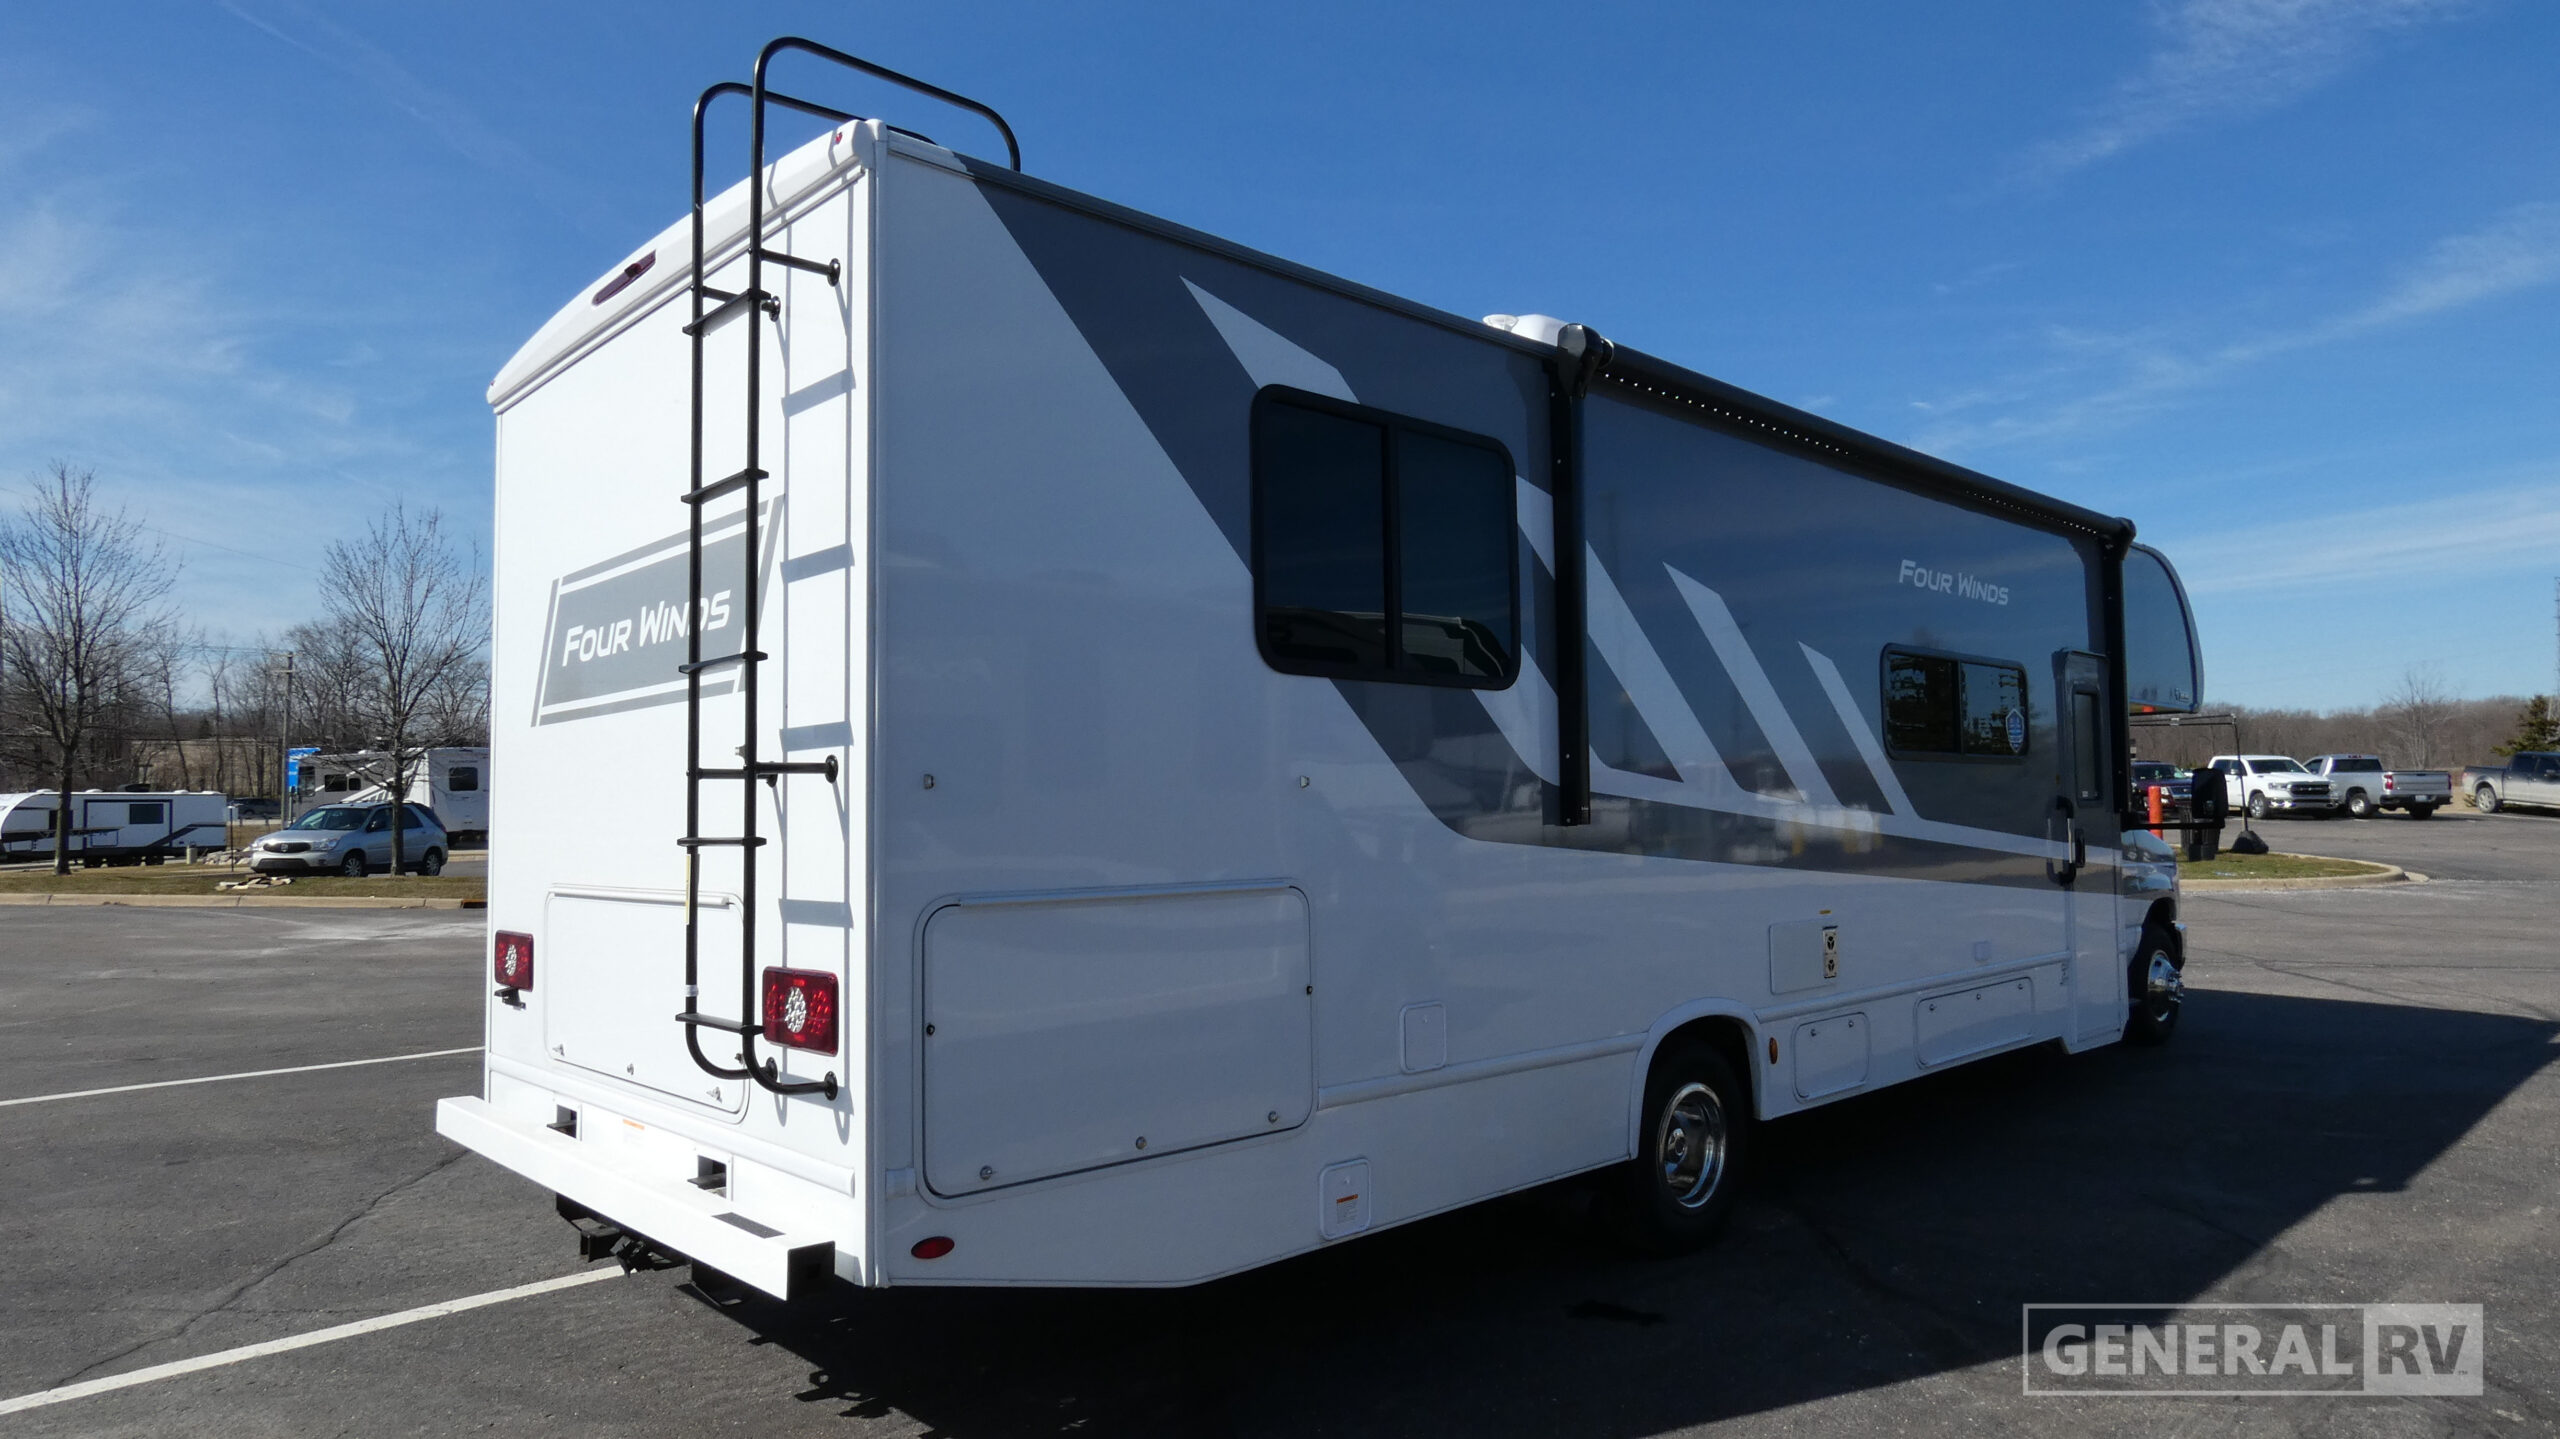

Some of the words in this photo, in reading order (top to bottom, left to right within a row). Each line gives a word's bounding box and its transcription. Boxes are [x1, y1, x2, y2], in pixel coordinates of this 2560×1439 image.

[1898, 558, 1953, 594] FOUR
[1957, 572, 2009, 606] WINDS
[562, 618, 633, 667] FOUR
